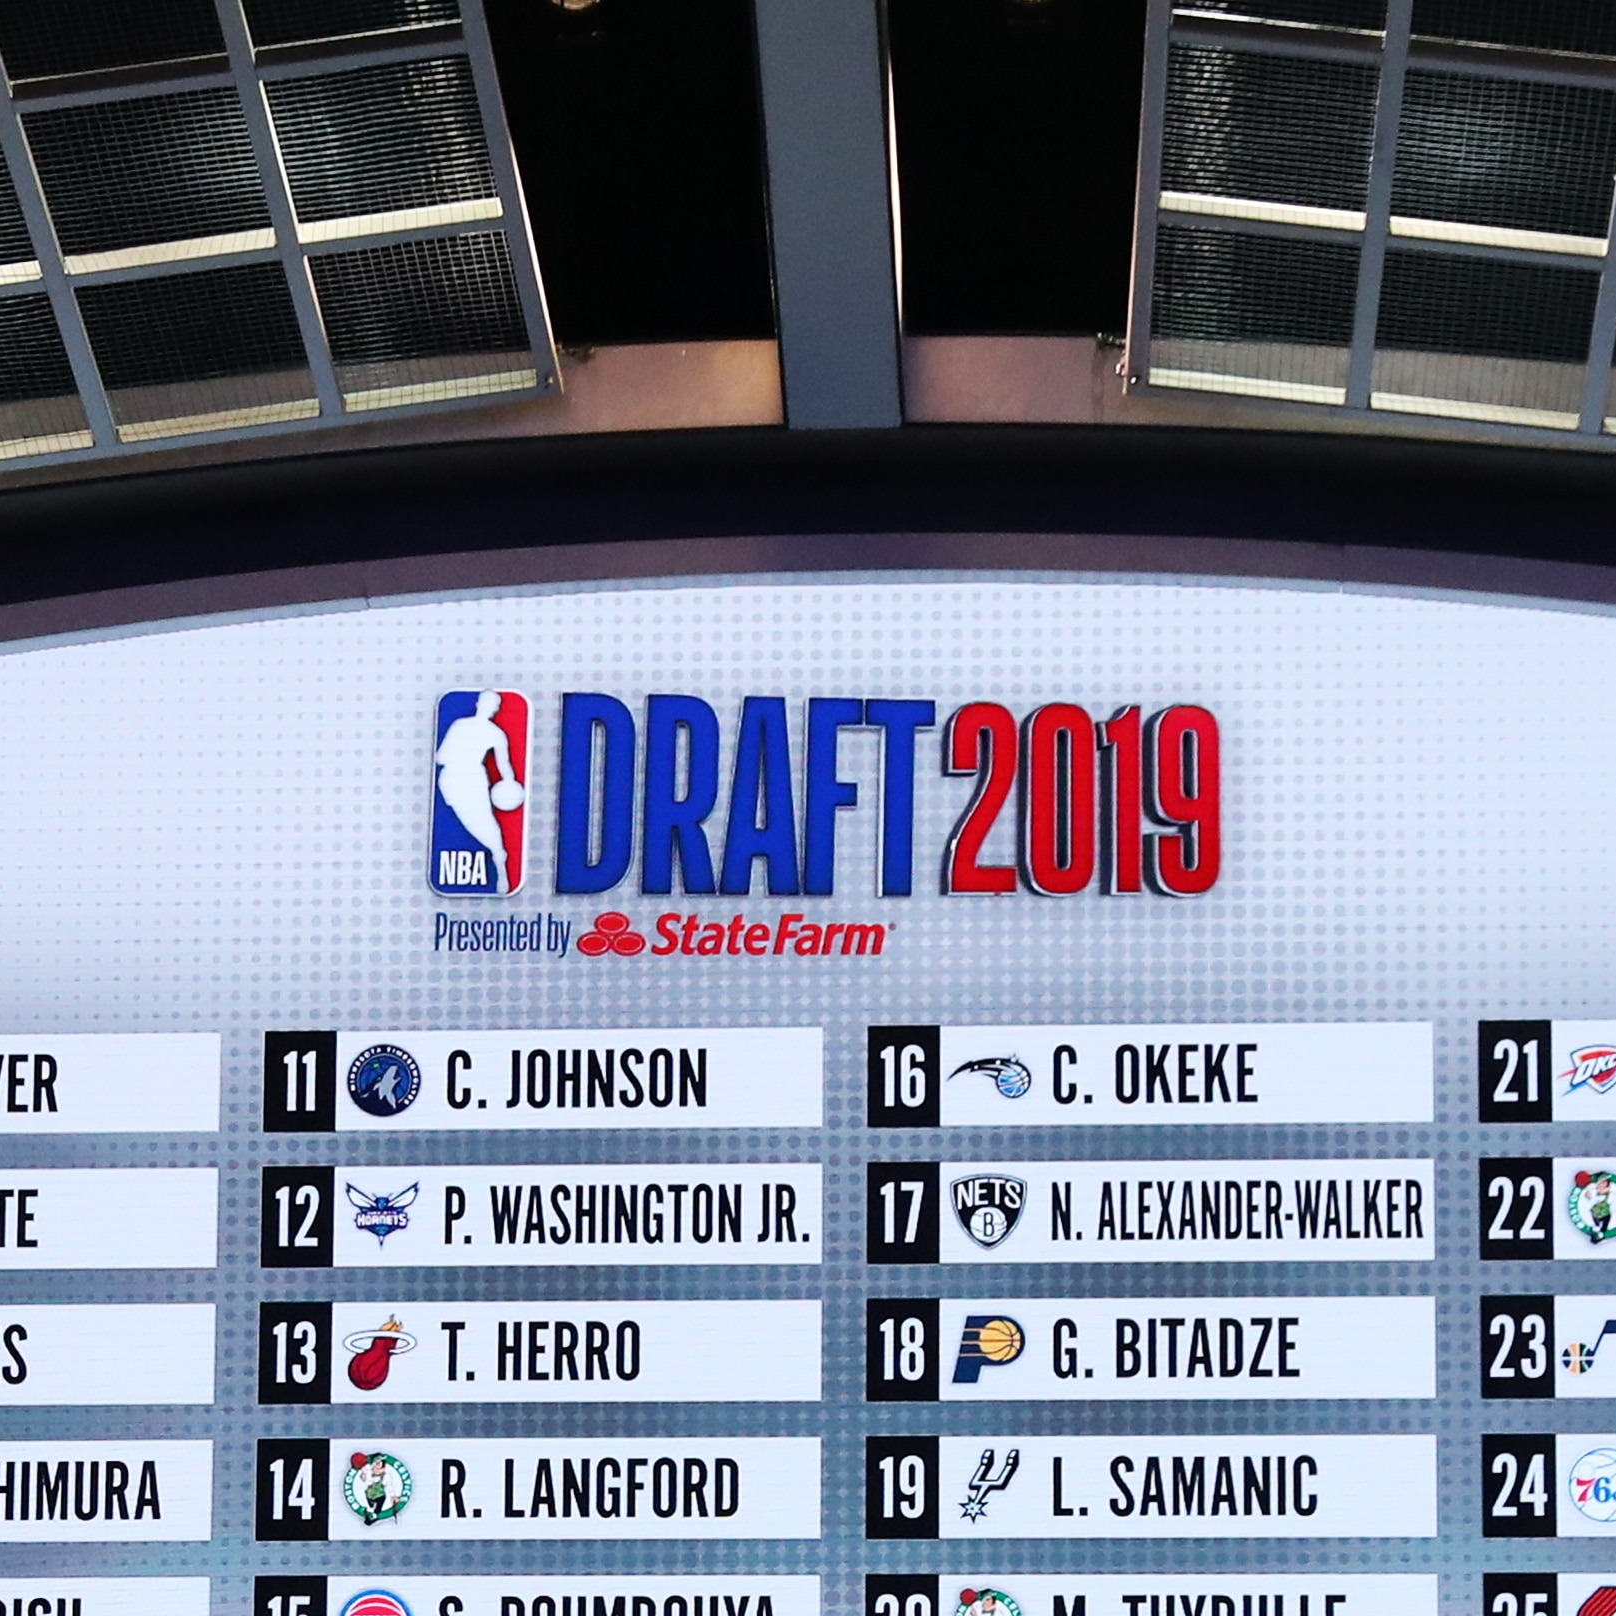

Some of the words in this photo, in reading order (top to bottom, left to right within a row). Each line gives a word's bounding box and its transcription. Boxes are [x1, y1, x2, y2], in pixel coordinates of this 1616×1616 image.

[555, 691, 937, 896] DRAFT
[946, 702, 1221, 894] 2019
[438, 850, 487, 885] NBA
[434, 911, 542, 952] Presented
[546, 912, 572, 958] by
[283, 1050, 317, 1112] 11
[446, 1049, 487, 1110] C.
[506, 1047, 707, 1109] JOHNSON
[880, 1044, 926, 1108] 16
[1052, 1044, 1093, 1105] C.
[1115, 1043, 1258, 1105] OKEKE
[1493, 1038, 1539, 1102] 21
[275, 1185, 320, 1247] 12
[444, 1185, 472, 1245] P.
[489, 1183, 742, 1245] WASHINGTON
[757, 1183, 810, 1243] JR.
[356, 1214, 409, 1227] HORNETS
[880, 1181, 924, 1244] 17
[1051, 1181, 1083, 1241] N.
[1097, 1179, 1424, 1241] ALEXANDER-WALKER
[957, 1179, 1022, 1209] NETS
[1488, 1176, 1545, 1240] 22
[272, 1320, 317, 1384] 13
[440, 1321, 475, 1381] T.
[497, 1320, 641, 1382] HERRO
[879, 1317, 925, 1381] 18
[1053, 1317, 1094, 1380] G.
[1115, 1317, 1300, 1378] BITADZE
[1489, 1314, 1547, 1379] 23
[269, 1458, 316, 1520] 14
[440, 1458, 482, 1519] R.
[504, 1456, 739, 1519] LANGFORD
[879, 1455, 925, 1519] 19
[1052, 1456, 1088, 1517] L.
[1109, 1454, 1318, 1517] SAMANIC
[1491, 1452, 1548, 1517] 24
